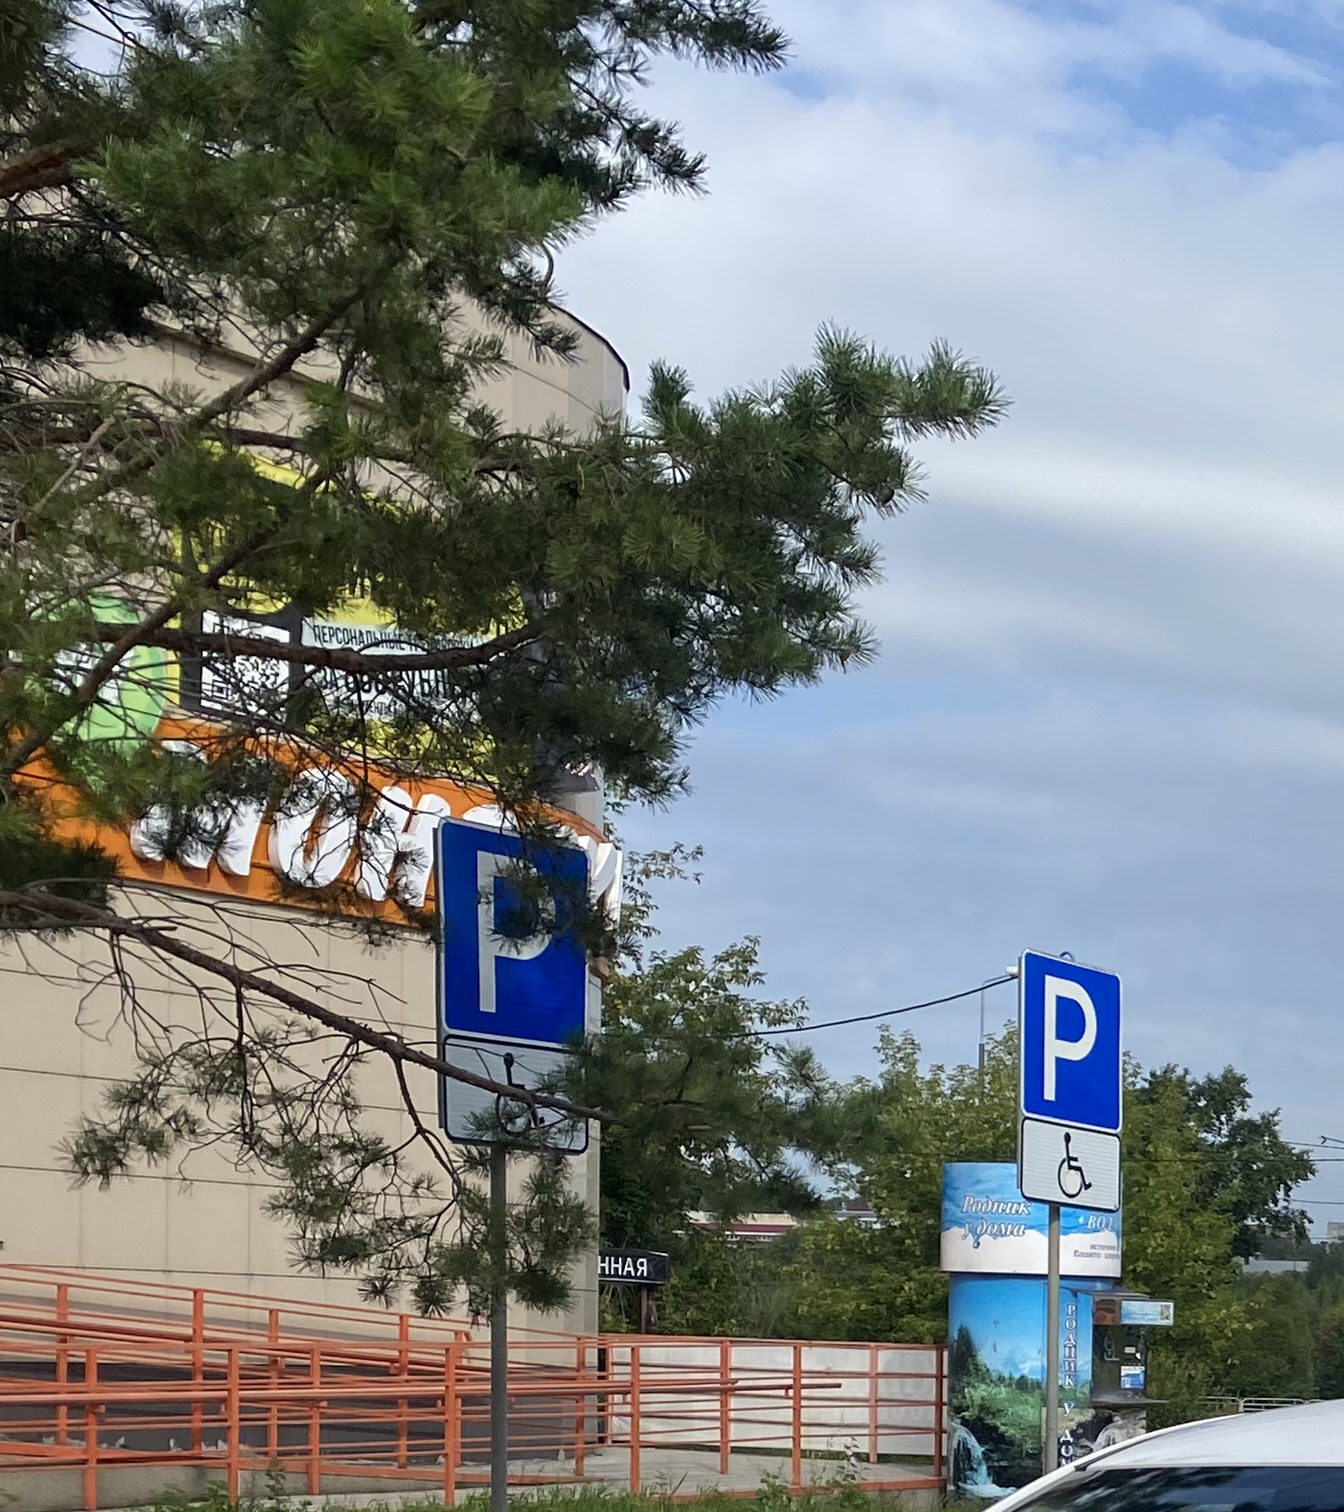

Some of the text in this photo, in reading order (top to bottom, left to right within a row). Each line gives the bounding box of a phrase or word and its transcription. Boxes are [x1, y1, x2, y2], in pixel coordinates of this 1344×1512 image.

[477, 850, 555, 1013] P
[1044, 975, 1097, 1101] P
[961, 1195, 1031, 1216] Родник
[976, 1220, 1026, 1238] дома
[598, 1255, 648, 1277] ННАЯ
[1062, 1402, 1075, 1416] У
